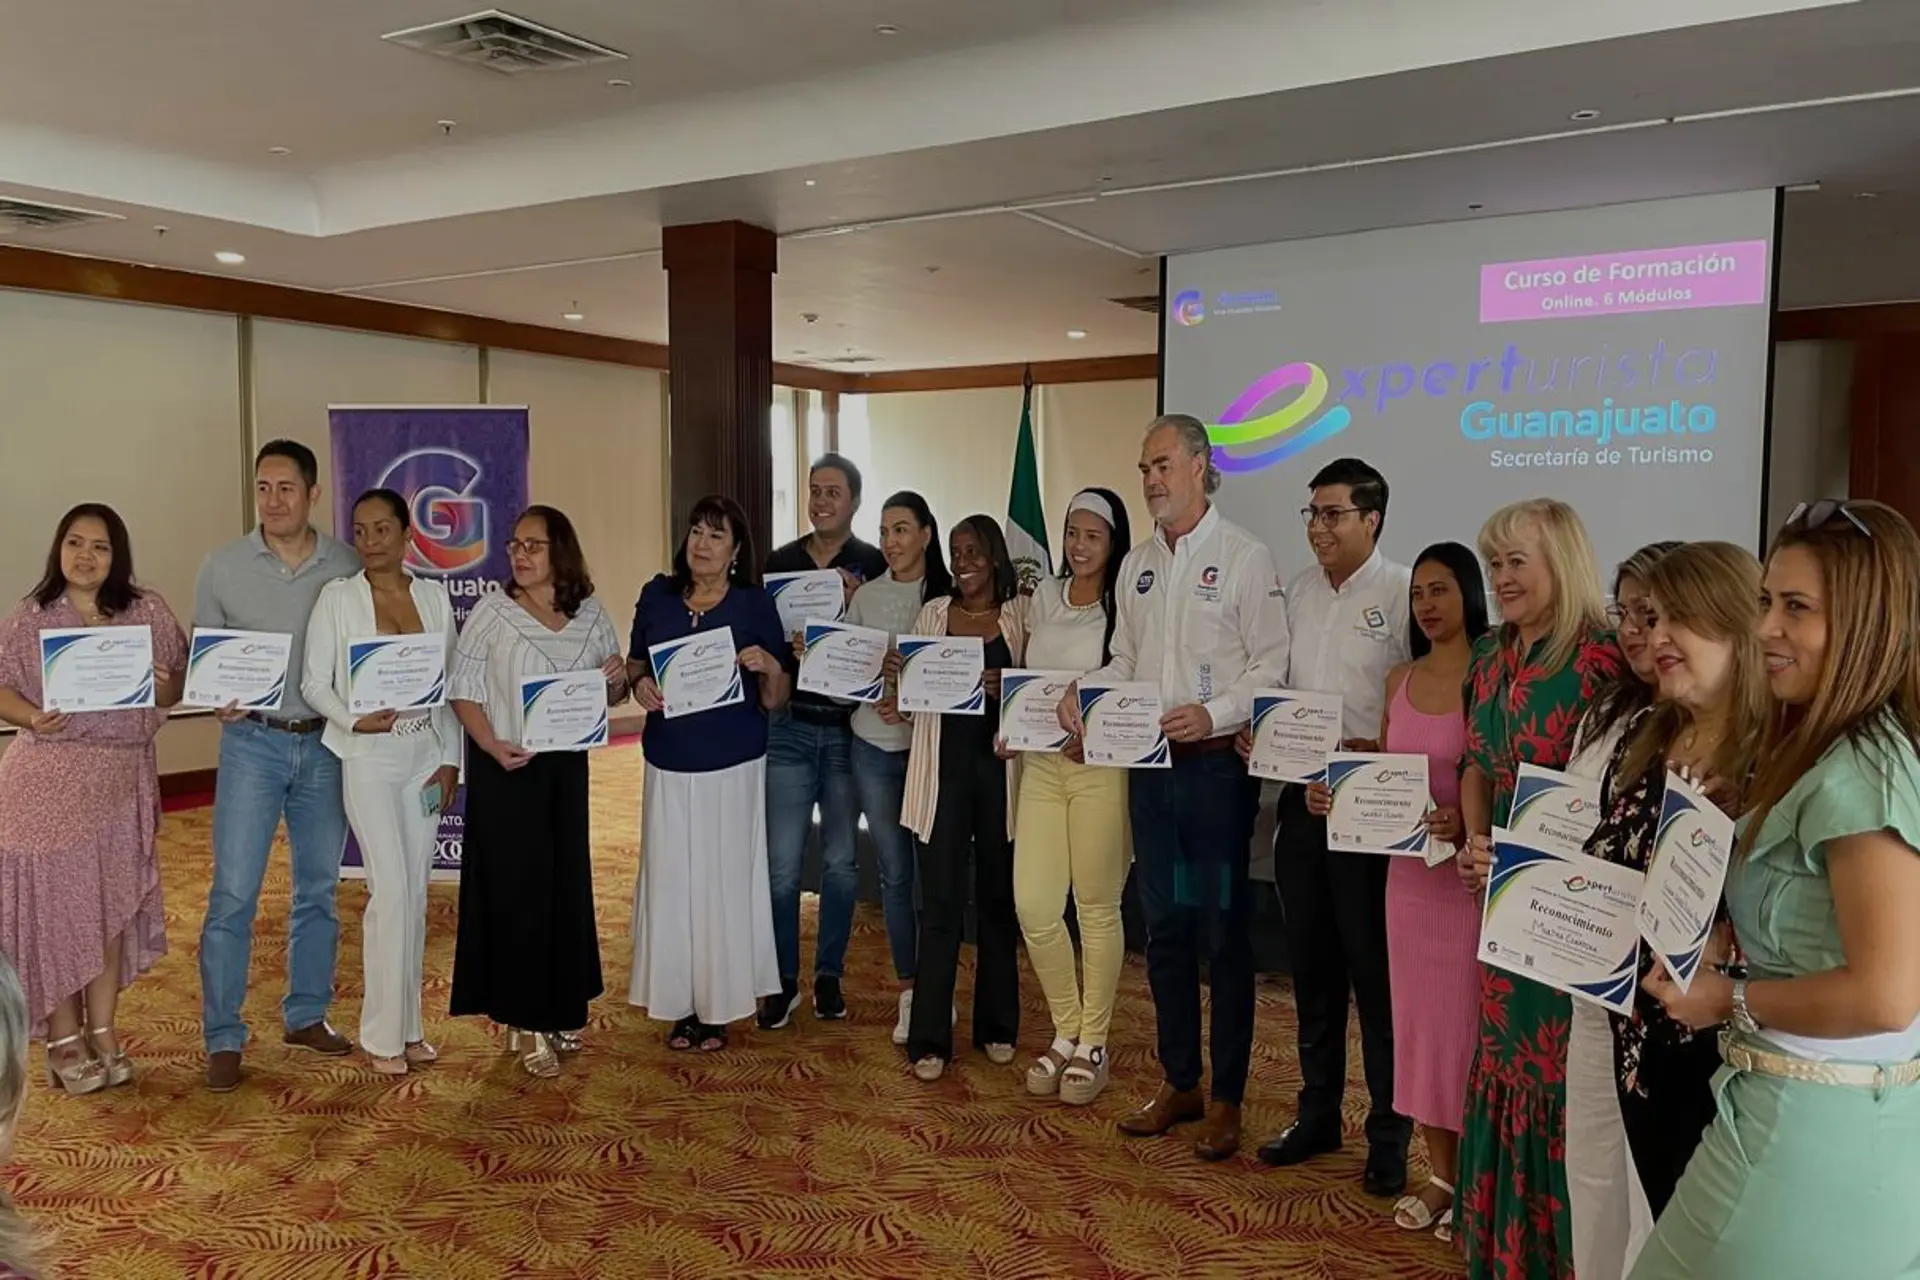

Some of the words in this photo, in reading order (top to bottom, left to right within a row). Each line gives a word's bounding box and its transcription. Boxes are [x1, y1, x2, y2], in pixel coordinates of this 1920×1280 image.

[1504, 269, 1567, 291] Curso
[1573, 265, 1601, 285] de
[1609, 252, 1737, 281] Formación
[1604, 292, 1613, 306] 6
[1618, 286, 1692, 306] Módulos
[1459, 397, 1717, 445] Guanajuato
[1490, 445, 1590, 469] Secretaría
[1595, 447, 1622, 466] de
[1627, 445, 1715, 465] Turismo
[1530, 898, 1614, 938] Reconocimiento
